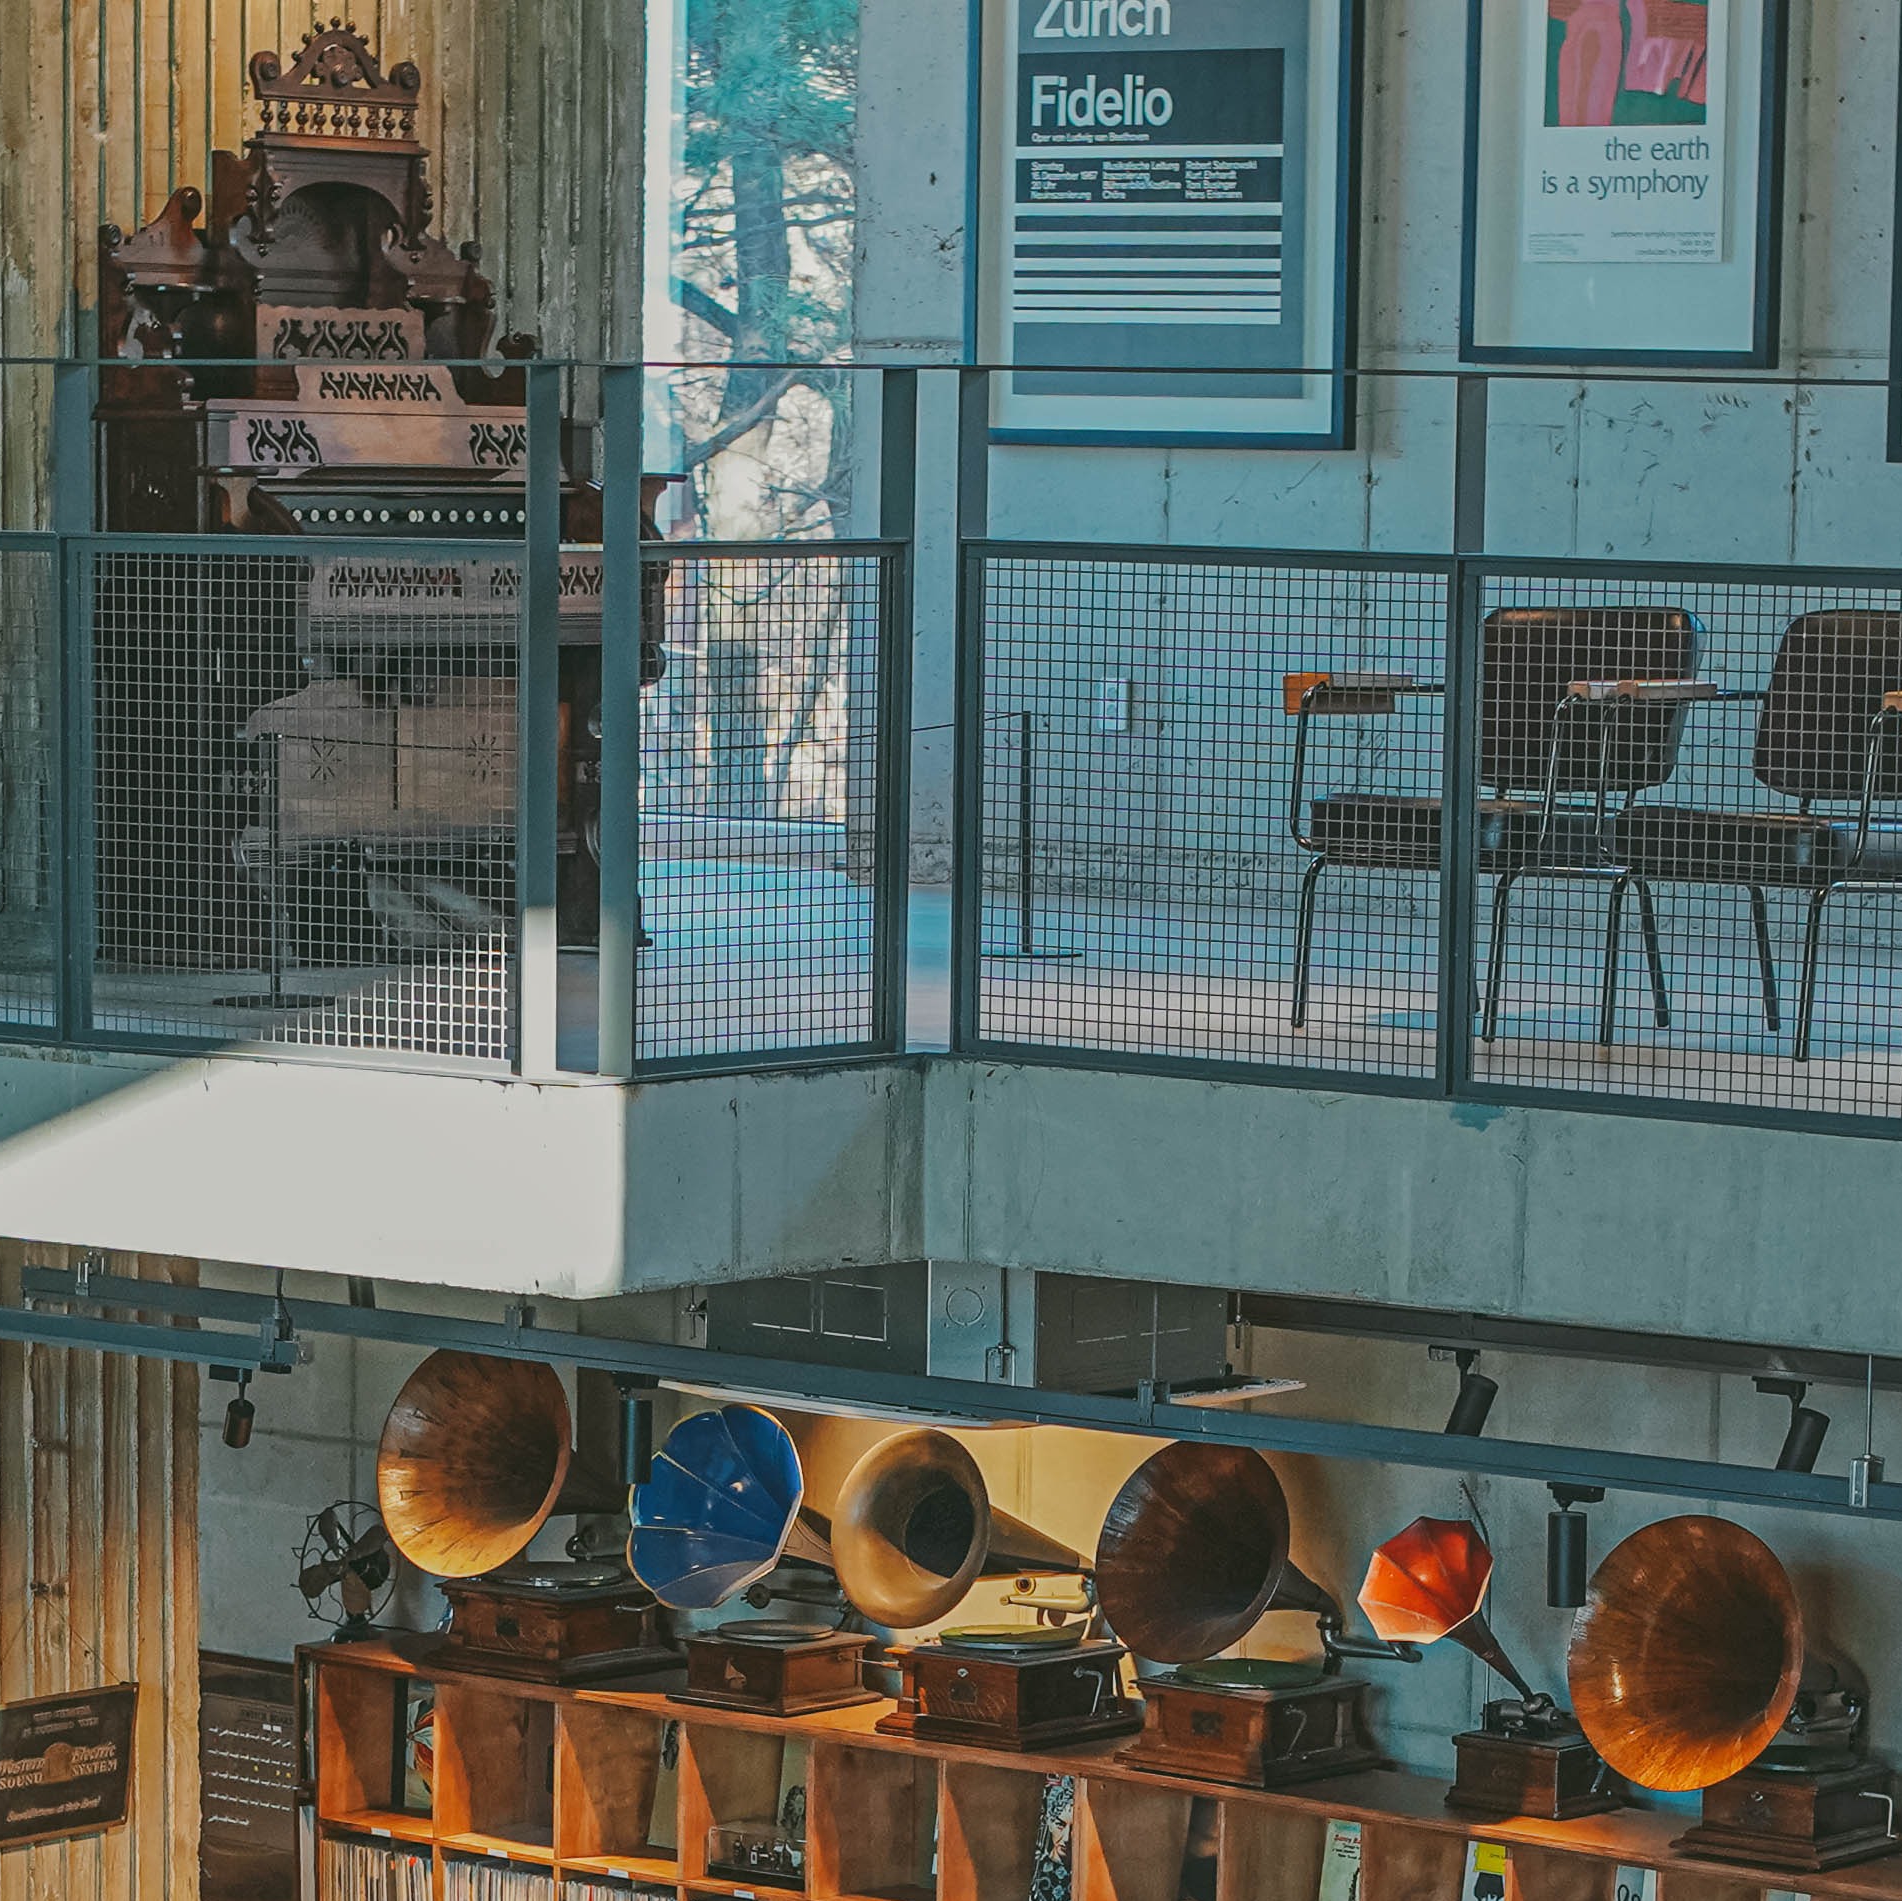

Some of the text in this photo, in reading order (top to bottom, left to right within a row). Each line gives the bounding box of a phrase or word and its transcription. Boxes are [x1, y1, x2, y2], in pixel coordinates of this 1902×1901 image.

[1031, 74, 1174, 127] Fidelio
[1605, 135, 1710, 161] the earth
[1541, 168, 1709, 200] is a symphony
[71, 1759, 118, 1777] SYSTEM
